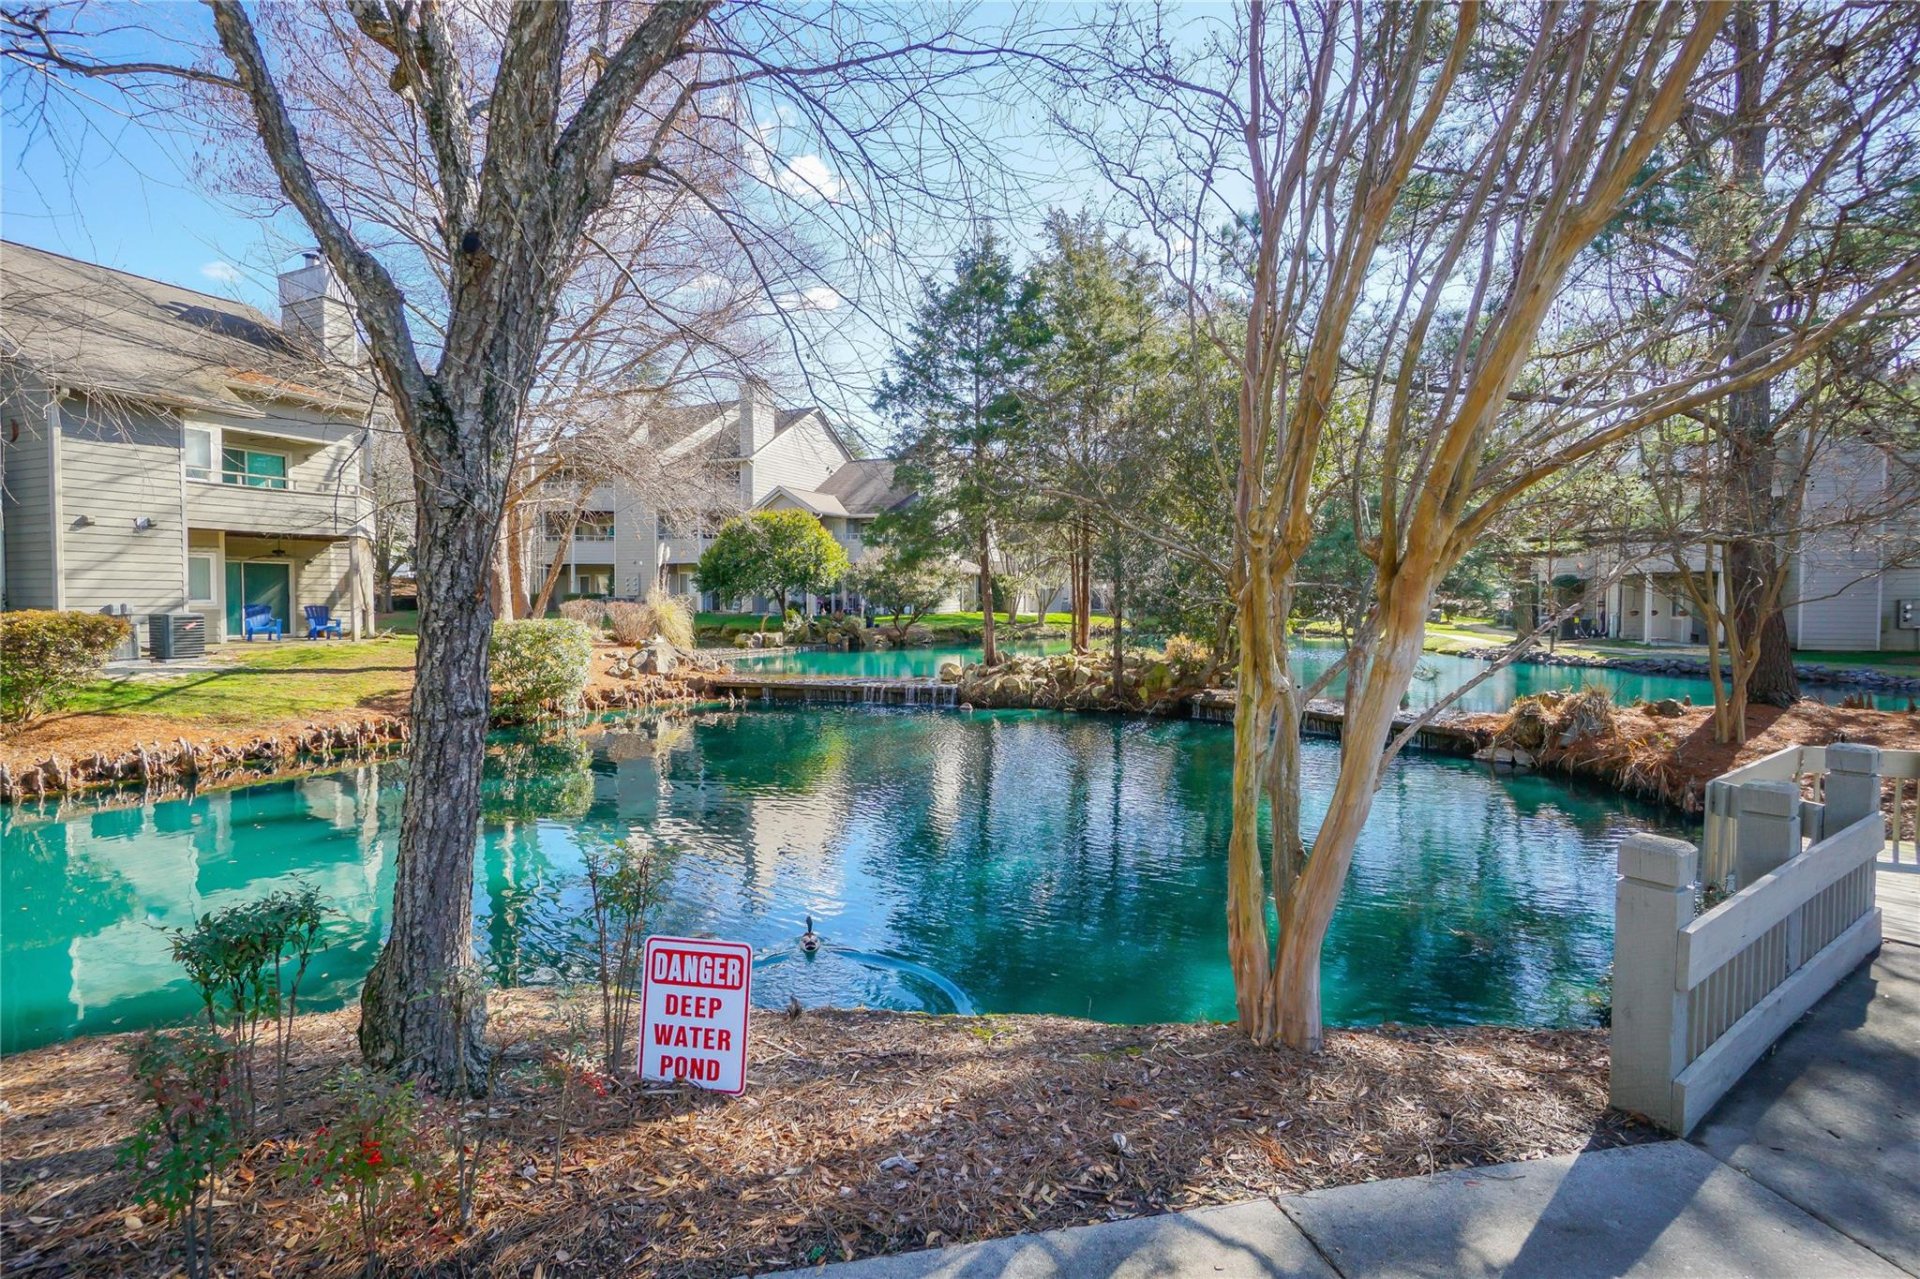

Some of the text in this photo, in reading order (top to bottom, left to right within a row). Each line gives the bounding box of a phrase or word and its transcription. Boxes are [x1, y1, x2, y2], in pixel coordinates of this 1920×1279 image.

[654, 952, 741, 987] DANGER
[665, 993, 723, 1019] DEEP
[654, 1023, 732, 1051] WATER
[659, 1055, 721, 1081] POND
